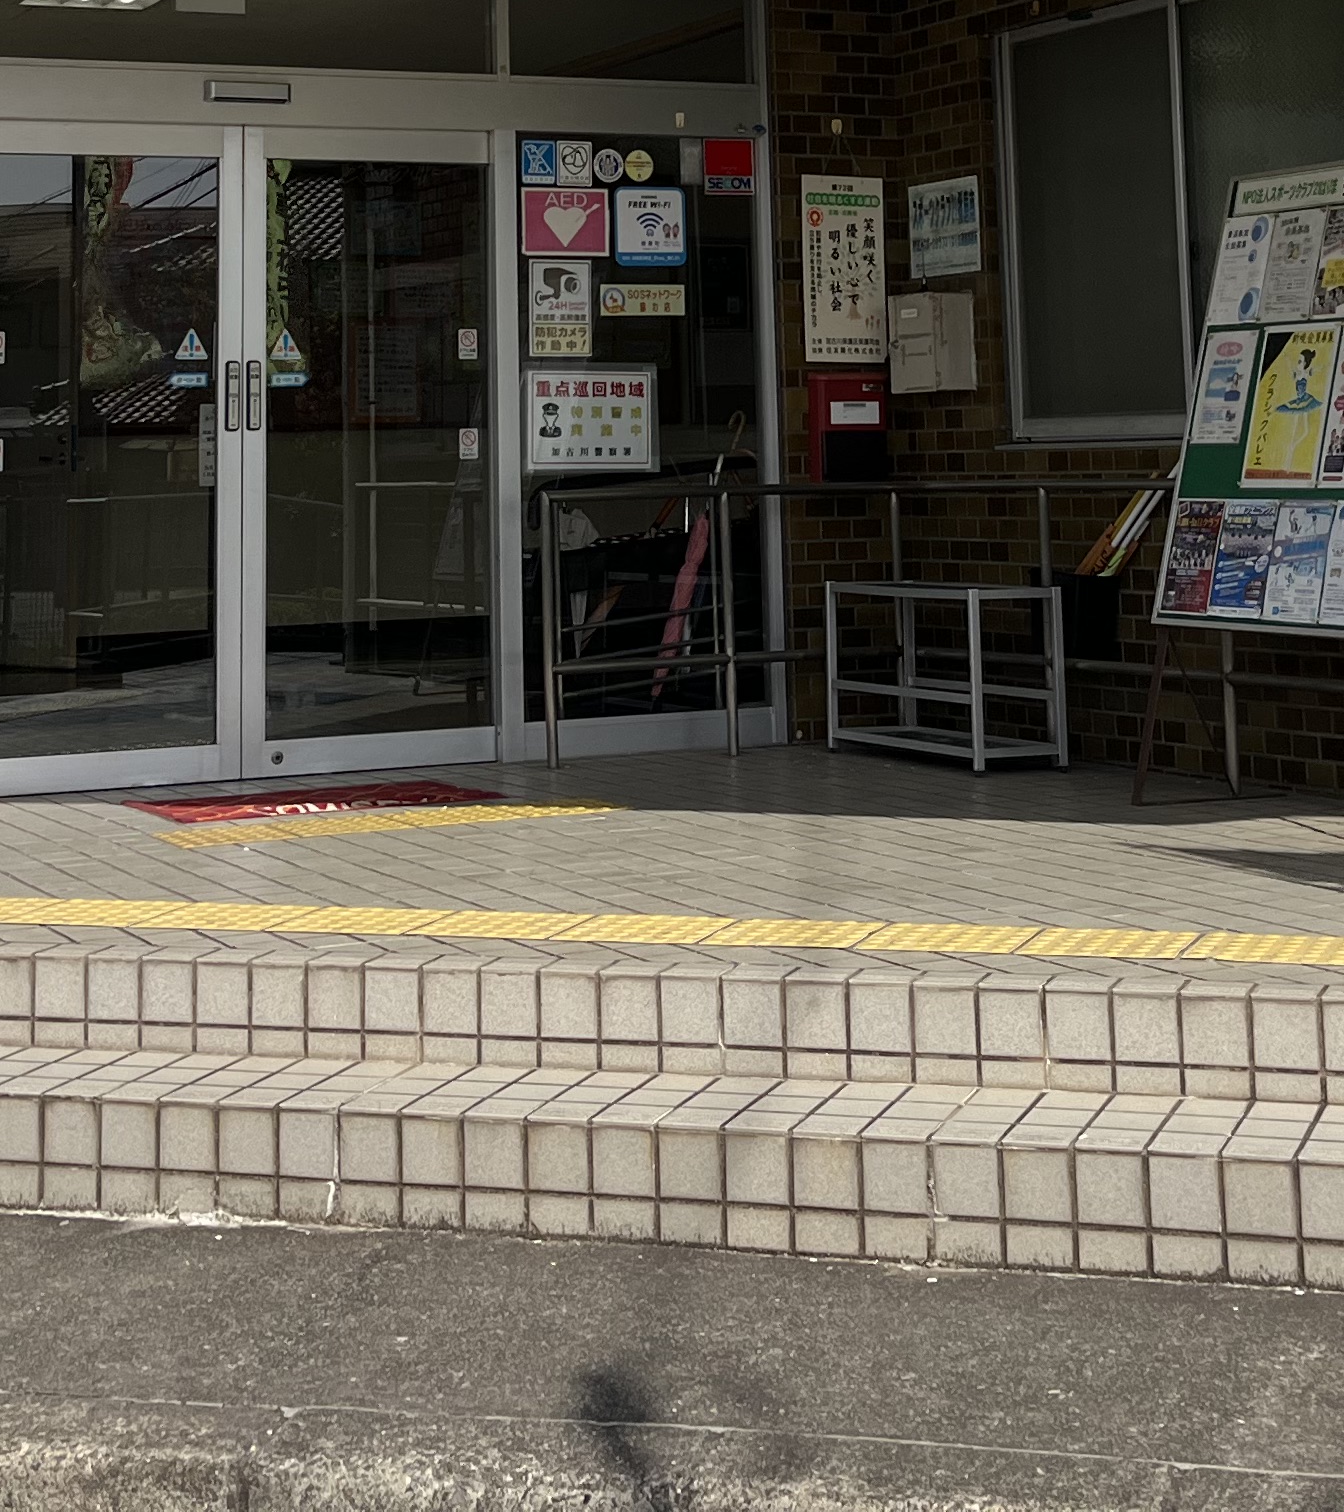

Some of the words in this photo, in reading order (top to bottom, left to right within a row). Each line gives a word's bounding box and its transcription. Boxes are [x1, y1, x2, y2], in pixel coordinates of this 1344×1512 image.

[544, 192, 588, 207] AED
[627, 201, 647, 209] FREE
[862, 217, 876, 284] 笑顔咲く
[828, 230, 843, 312] 明るい社会
[845, 223, 860, 306] 優しい心で
[534, 327, 587, 338] 防犯カメラ
[535, 380, 645, 398] 重点巡回地域
